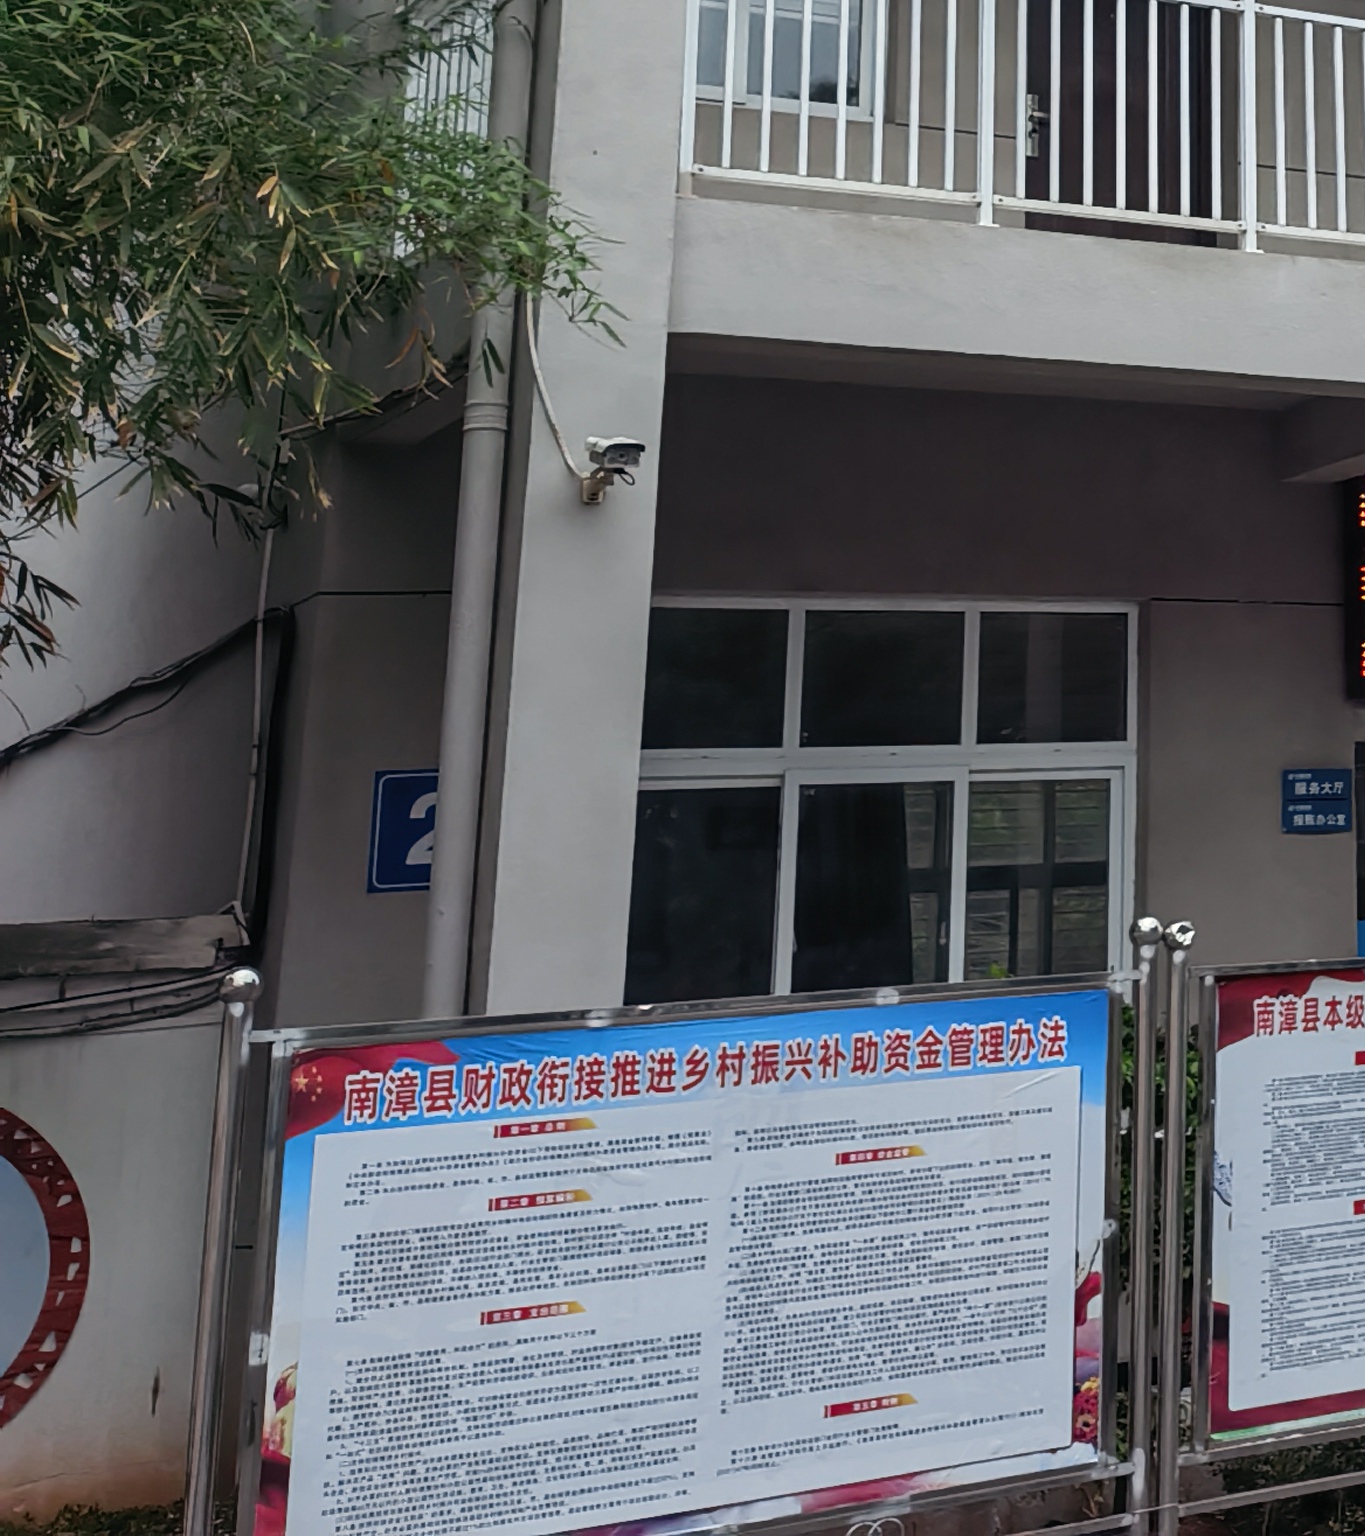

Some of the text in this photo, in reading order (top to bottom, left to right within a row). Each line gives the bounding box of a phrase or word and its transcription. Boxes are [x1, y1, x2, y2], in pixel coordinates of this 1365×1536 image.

[345, 1017, 1068, 1123] 南漳县财政衔接推进乡村振兴补助资金管理办法
